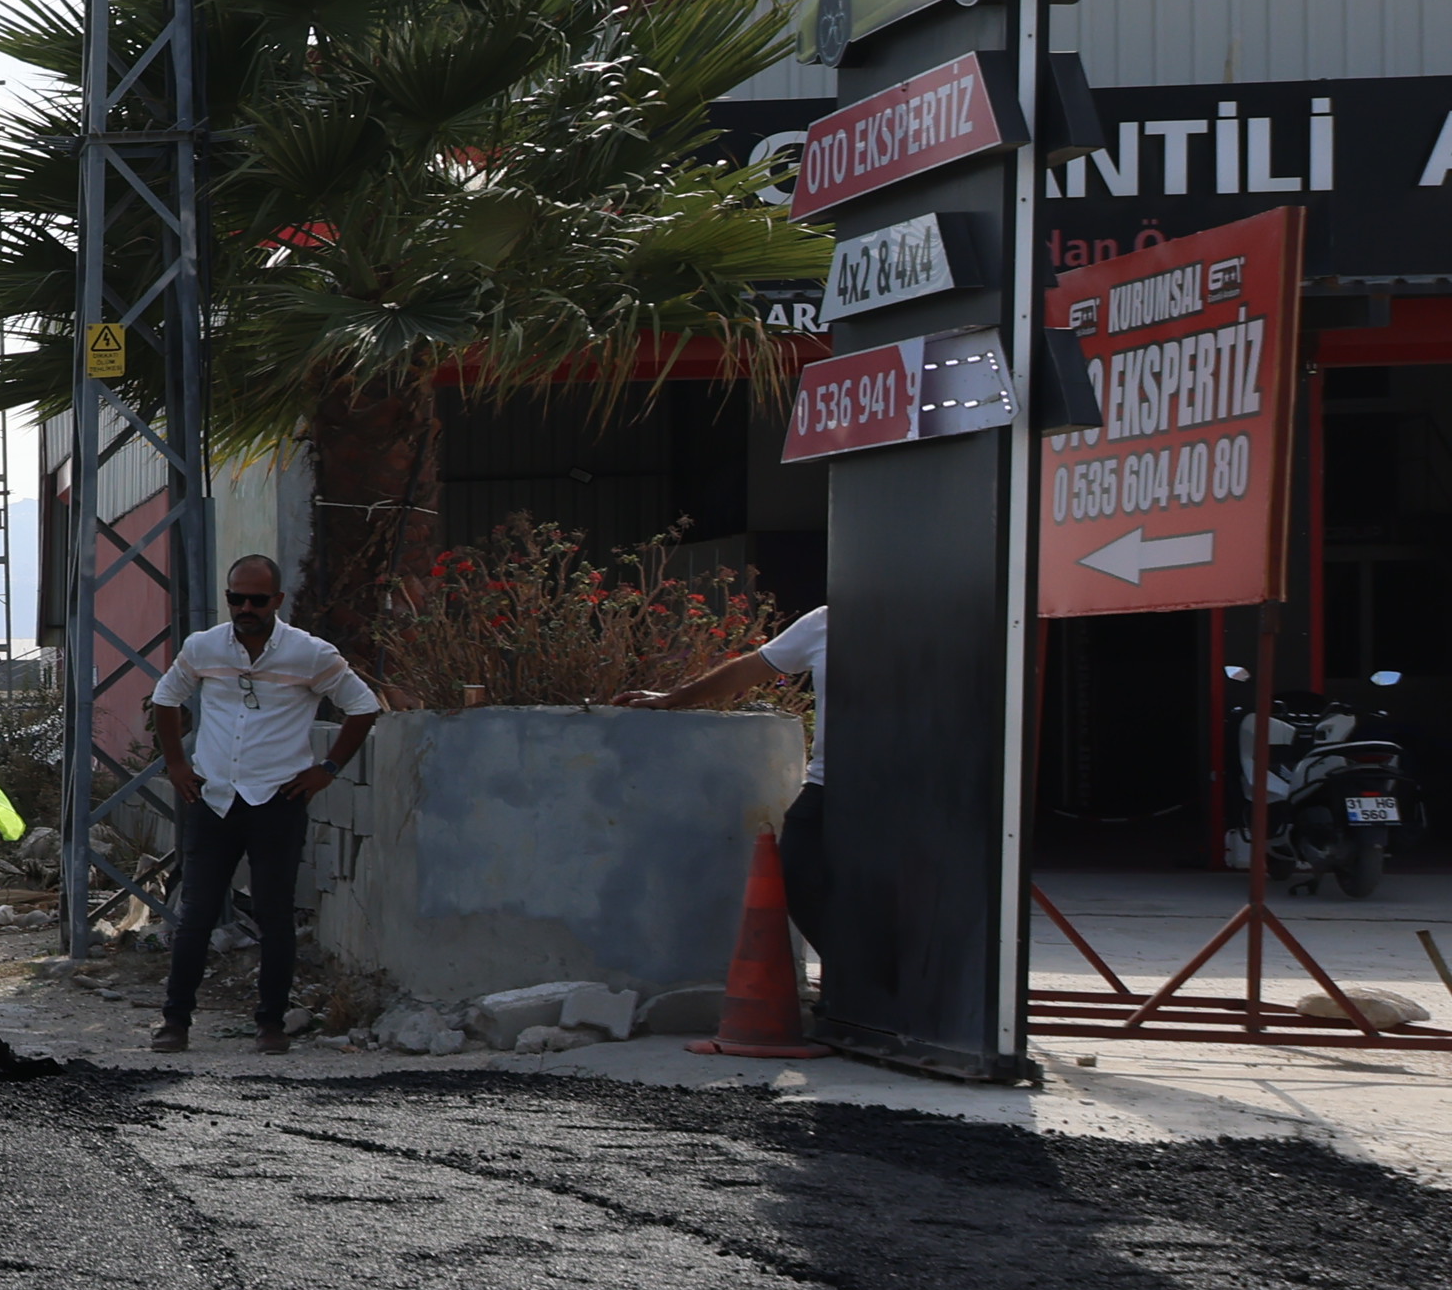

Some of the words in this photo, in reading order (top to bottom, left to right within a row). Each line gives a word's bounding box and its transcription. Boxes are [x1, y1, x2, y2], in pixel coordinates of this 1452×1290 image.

[807, 128, 848, 194] OTO
[854, 63, 975, 177] EKSPERTİZ
[837, 246, 871, 306] 4x2
[876, 240, 893, 296] &
[895, 225, 933, 289] 4x4
[1133, 219, 1167, 253] Ö
[766, 303, 832, 333] AR
[1108, 263, 1204, 333] KURUMSAL
[797, 389, 809, 437] 0
[815, 379, 852, 433] 536
[858, 369, 895, 425] 941
[1108, 306, 1265, 441] EKSPERTİZ
[1053, 466, 1068, 522] 0
[1072, 459, 1119, 520] 535
[1121, 449, 1169, 513] 604
[1173, 442, 1208, 504] 40
[1213, 435, 1250, 500] 80
[1347, 799, 1362, 809] 31
[1375, 798, 1395, 809] HG
